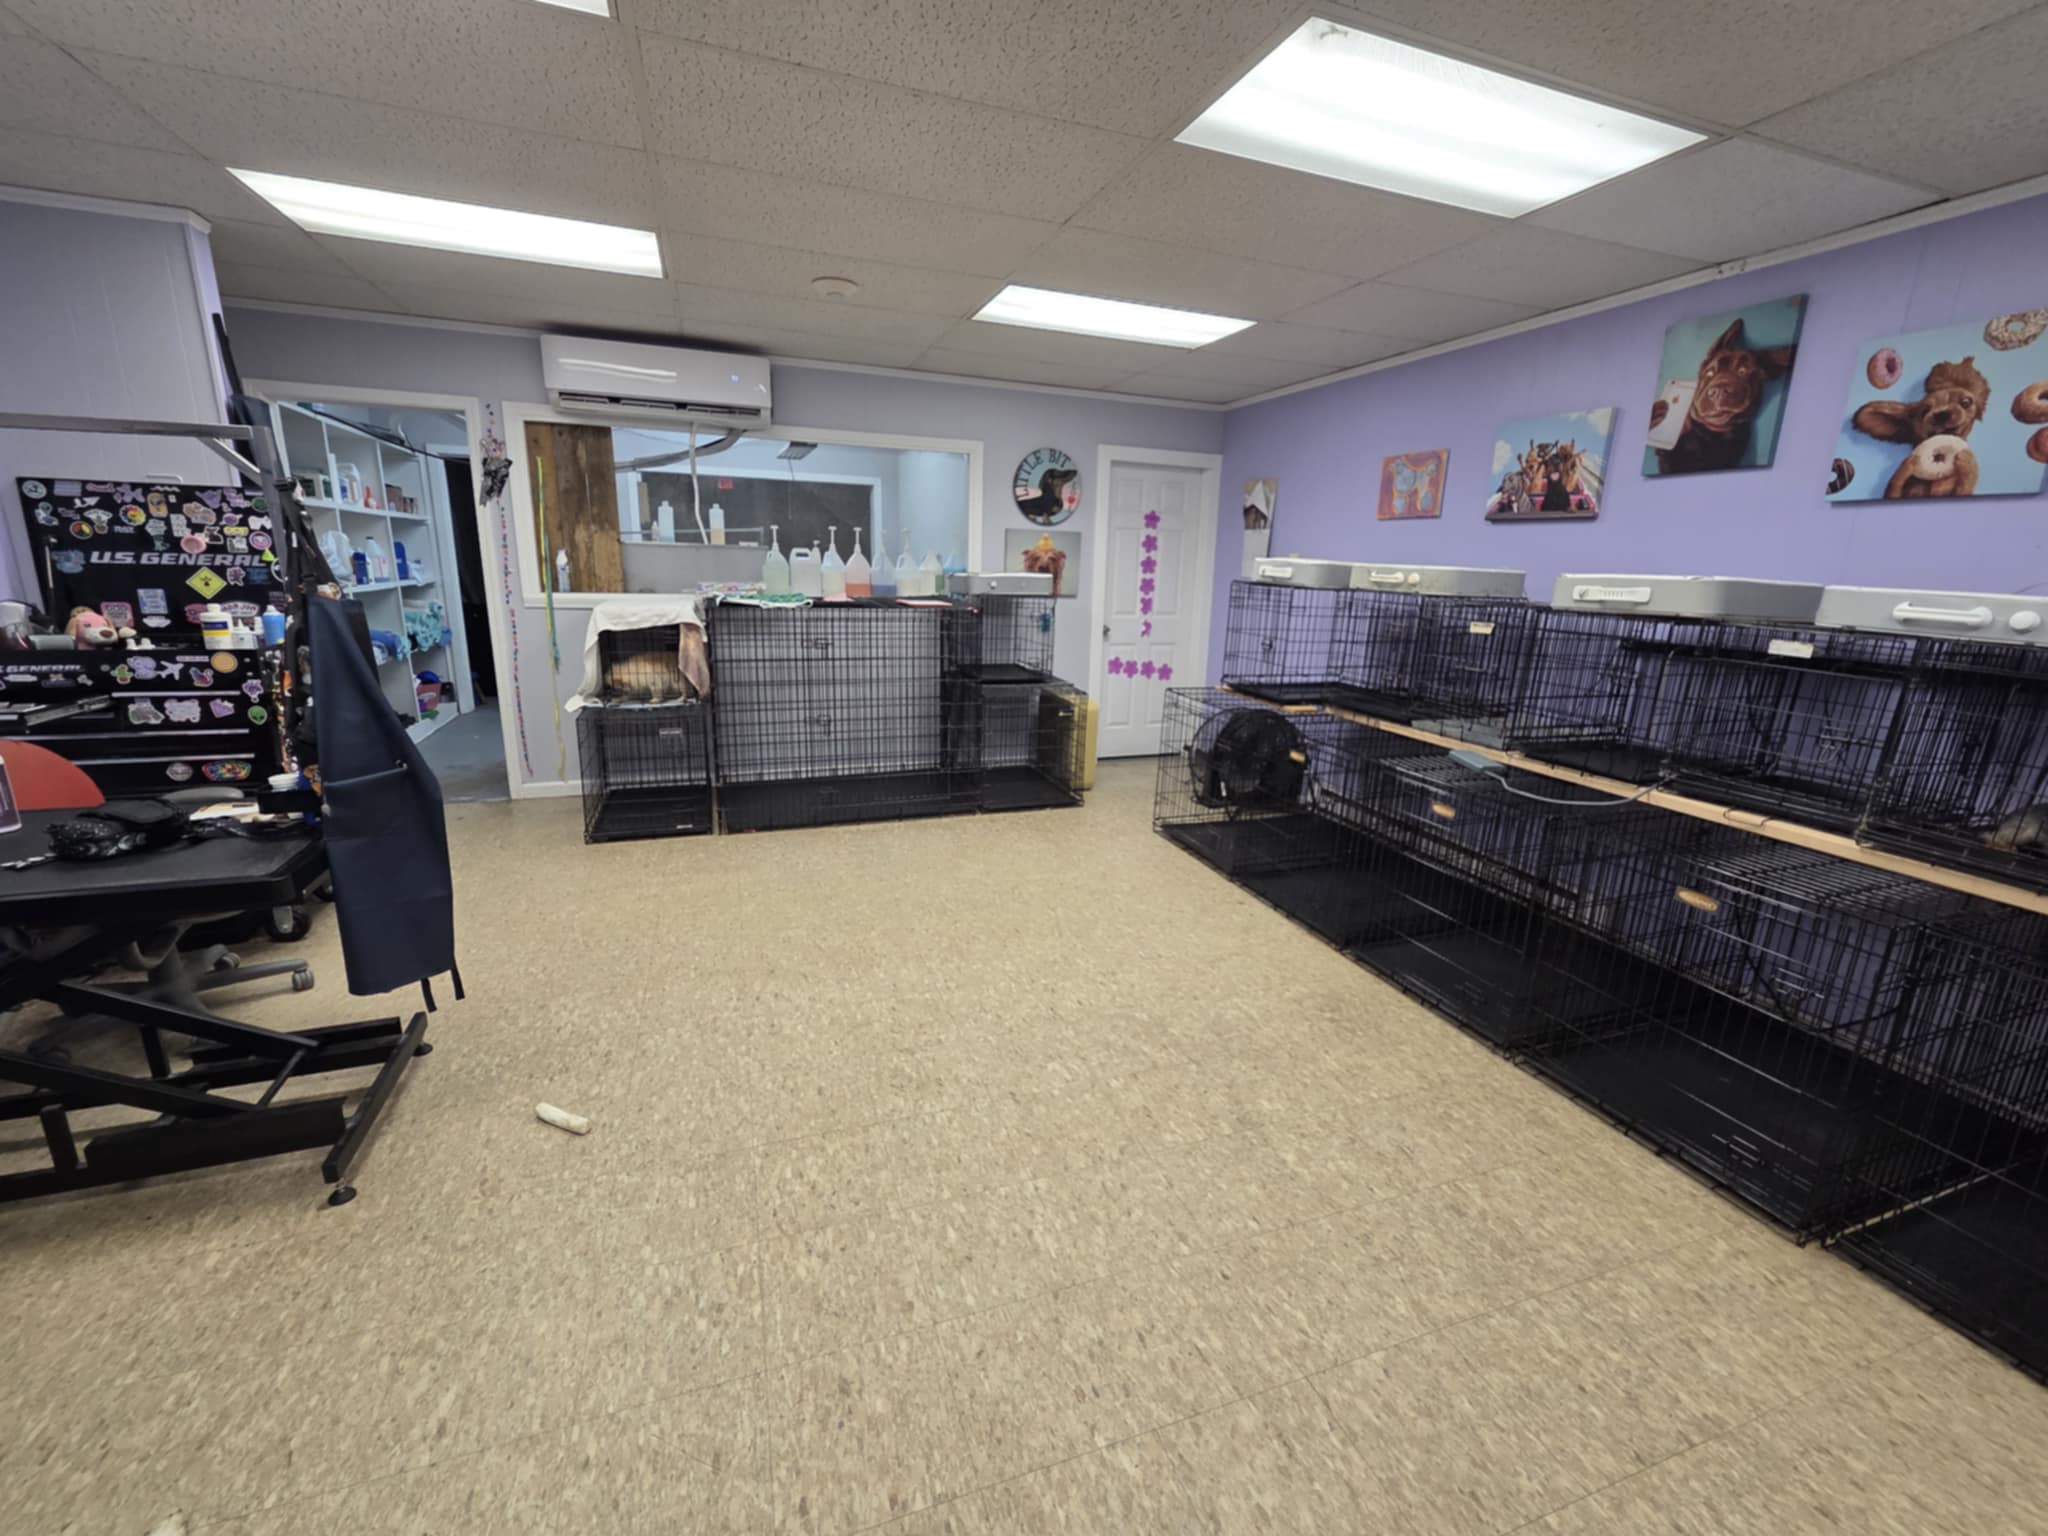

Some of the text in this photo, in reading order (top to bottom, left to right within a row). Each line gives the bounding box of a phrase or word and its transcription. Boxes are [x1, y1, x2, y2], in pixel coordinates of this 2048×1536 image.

[1015, 450, 1071, 497] LITTLE BIT
[140, 552, 267, 567] GENERAL
